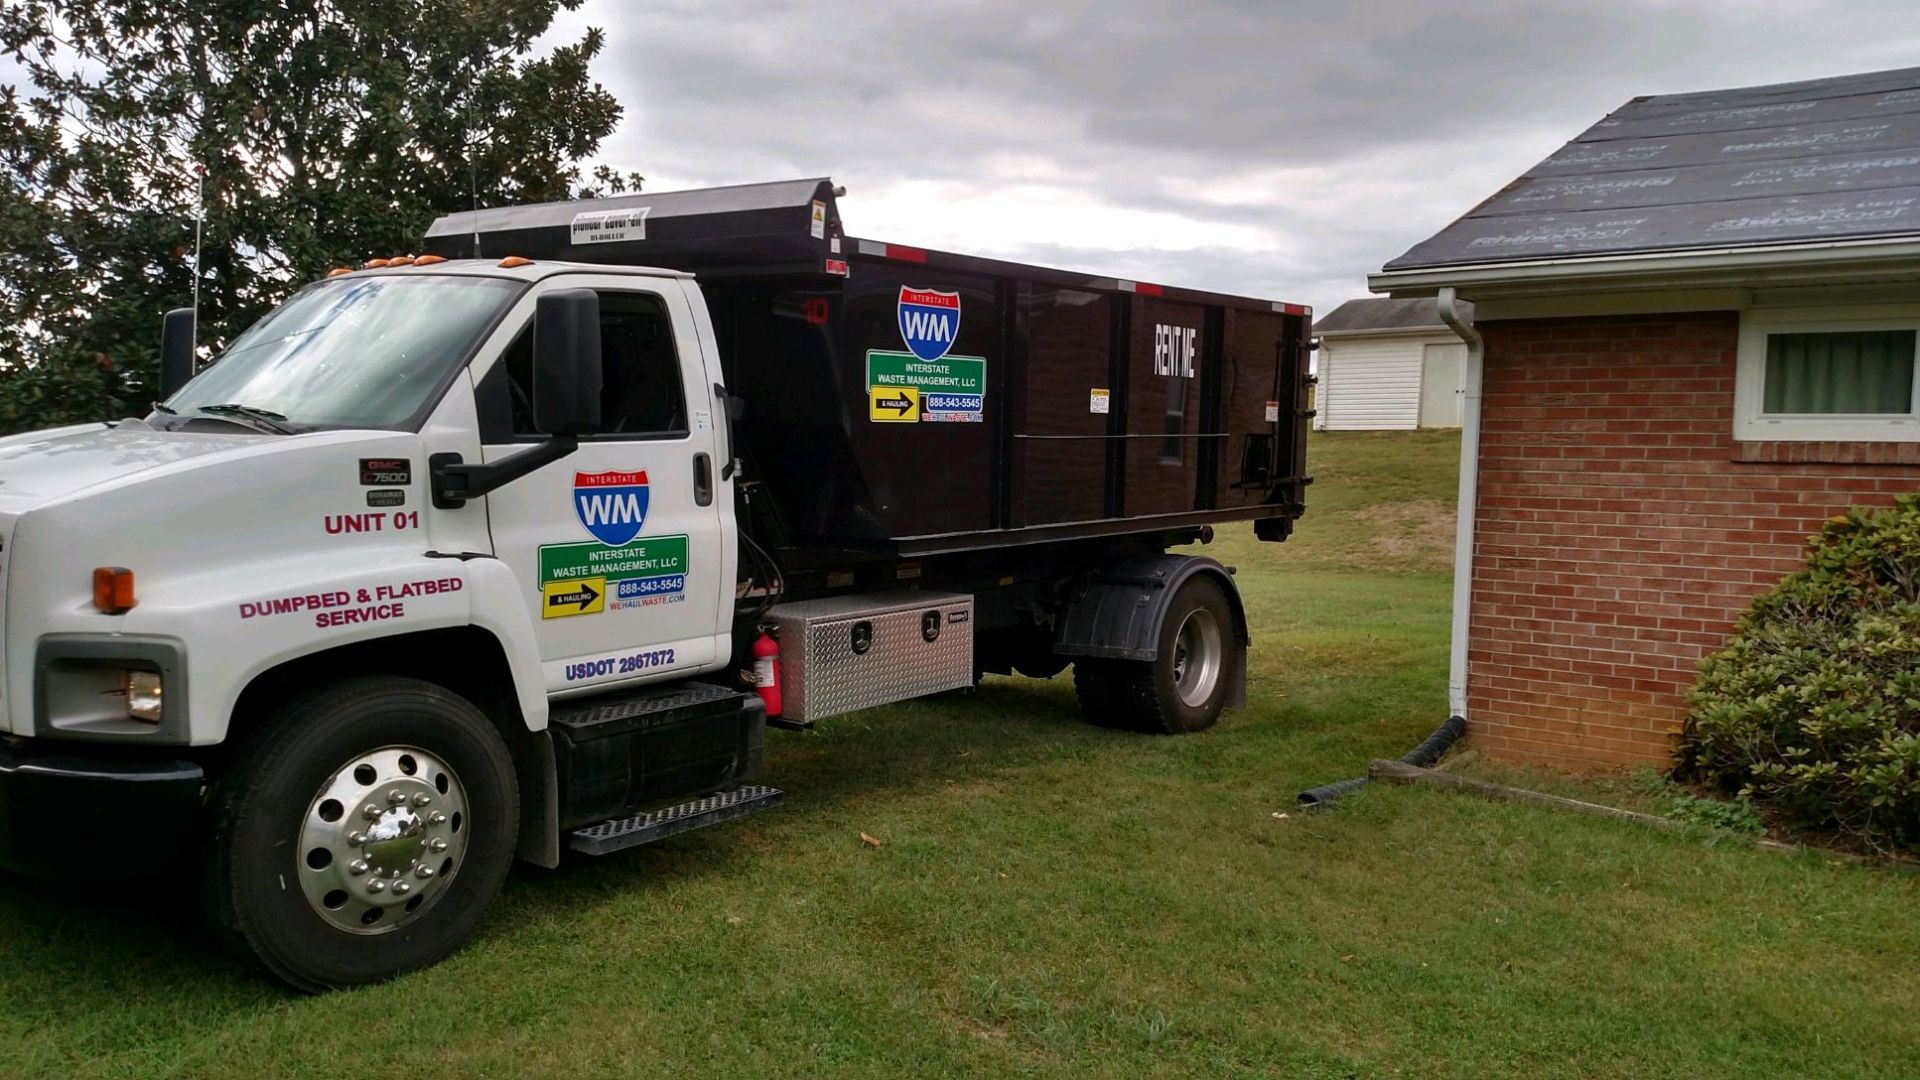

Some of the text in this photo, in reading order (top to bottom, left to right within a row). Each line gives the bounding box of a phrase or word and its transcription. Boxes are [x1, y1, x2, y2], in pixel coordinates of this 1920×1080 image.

[910, 294, 950, 306] INTERSTATE
[904, 311, 950, 342] WM
[1154, 323, 1196, 378] RENT ME
[906, 363, 950, 374] INTERSTATE
[878, 374, 976, 388] WASTE MANAGEMENT, LLC
[929, 397, 980, 408] 888-543-5545
[367, 461, 401, 469] GMC
[586, 475, 637, 485] INTERSTATE
[580, 493, 642, 526] WM
[325, 511, 419, 535] UNIT 01
[589, 548, 646, 561] INTERSTATE
[553, 557, 678, 578] WASTE MANAGEMENT, LLC
[619, 577, 683, 595] 888-543-5545
[239, 577, 463, 619] DUMPBED & FLATBED
[563, 592, 592, 603] HAULING
[610, 594, 685, 610] WEHAULWASTE.COM
[315, 602, 404, 628] SERVICE
[565, 648, 675, 681] USDOT 2867872
